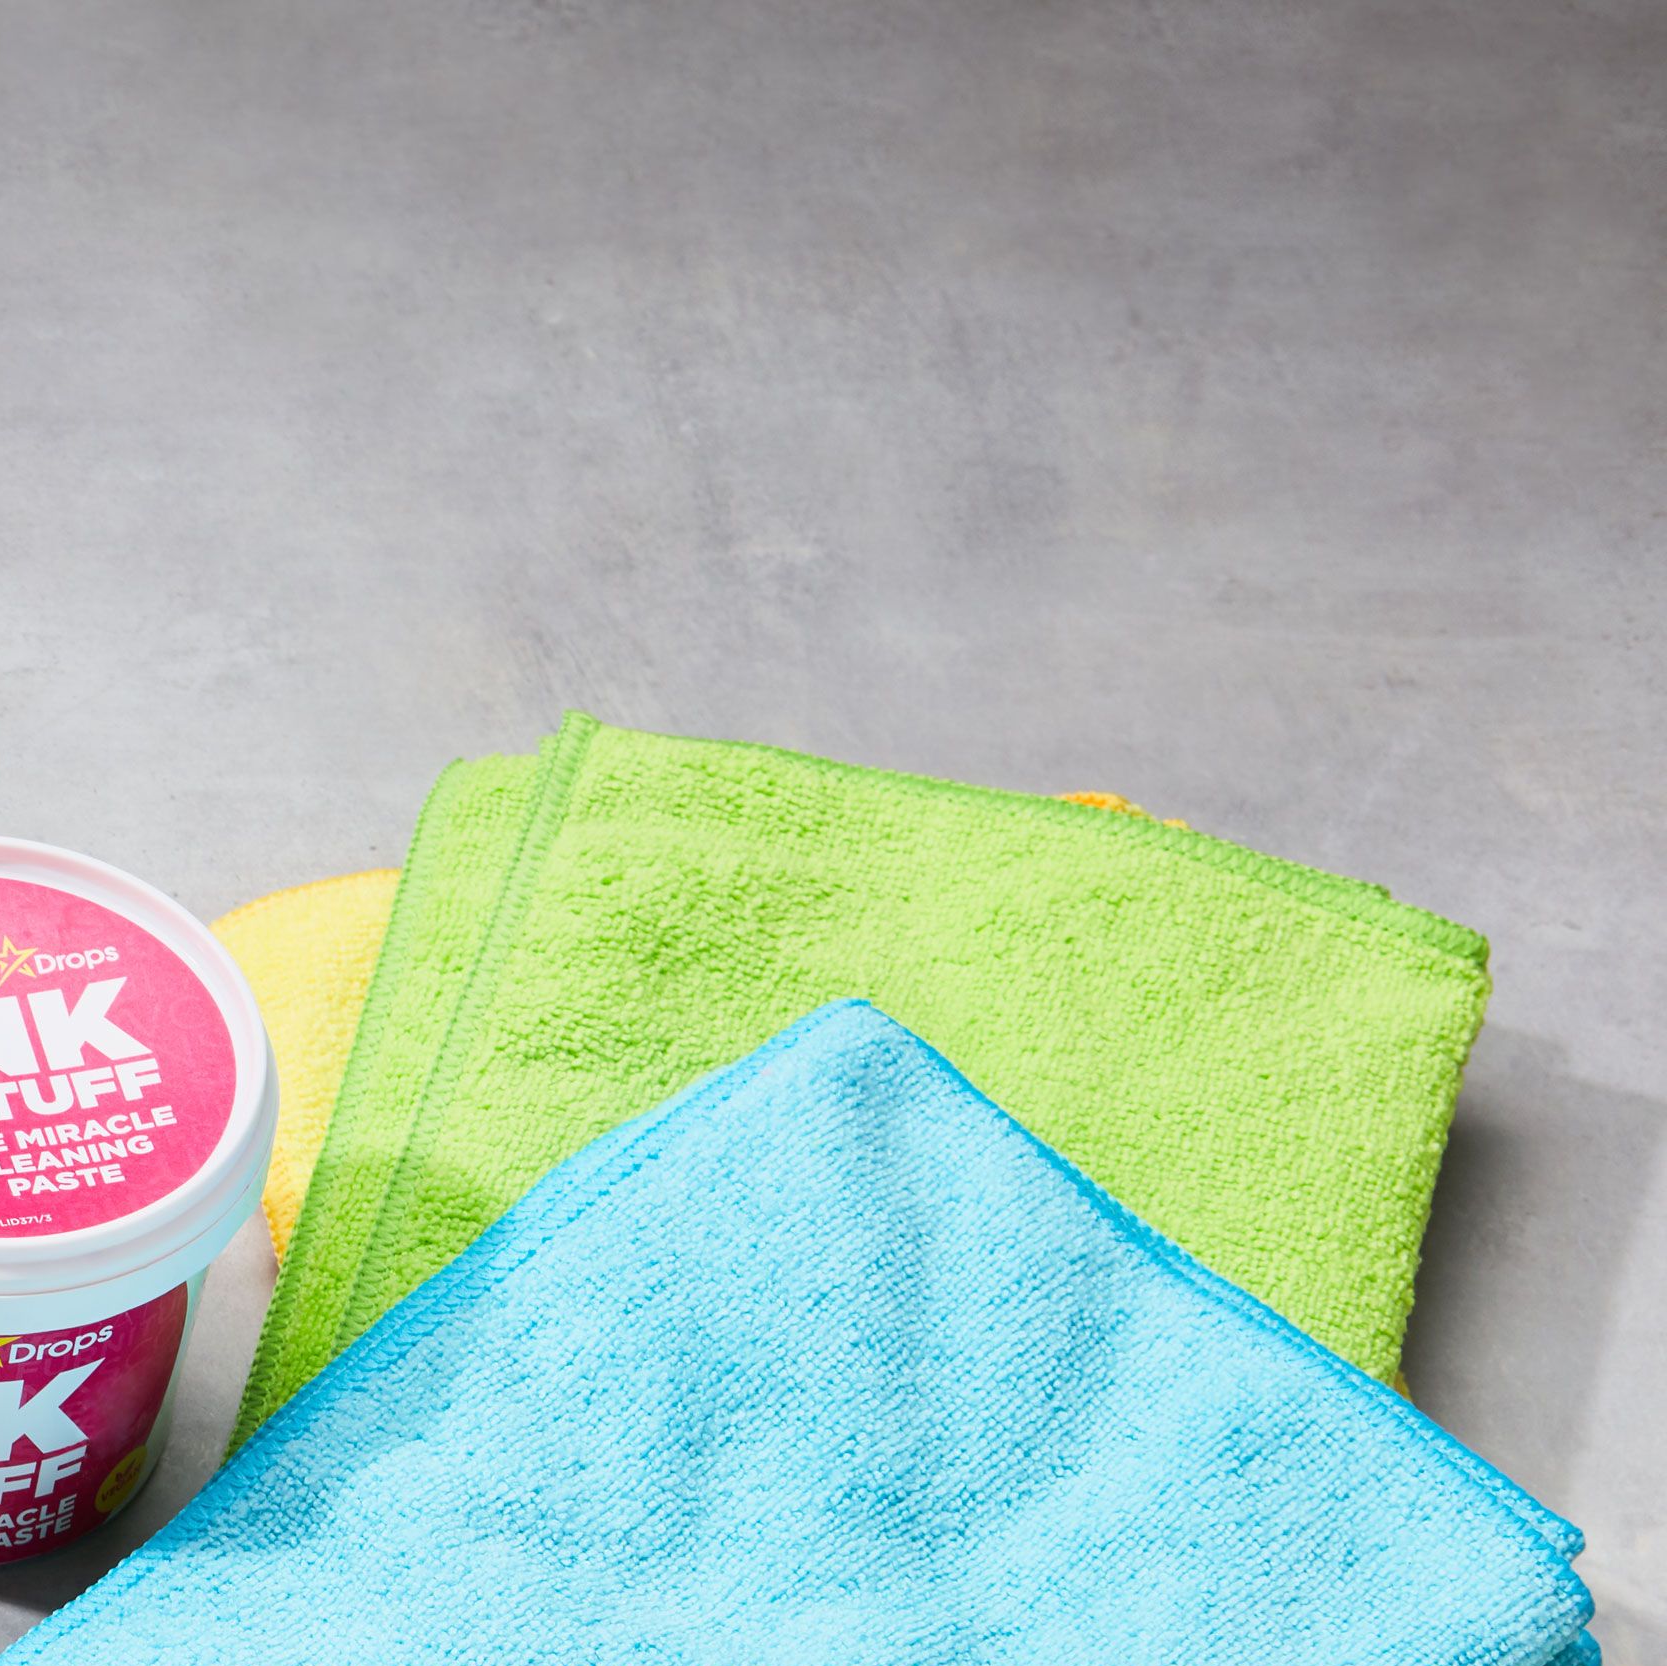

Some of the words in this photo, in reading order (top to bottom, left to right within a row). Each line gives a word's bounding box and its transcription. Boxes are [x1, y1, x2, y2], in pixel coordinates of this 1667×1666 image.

[34, 945, 120, 976] Drops
[14, 1105, 178, 1150] MIRACLE
[7, 1163, 127, 1197] PASTE
[8, 1324, 114, 1365] Drops
